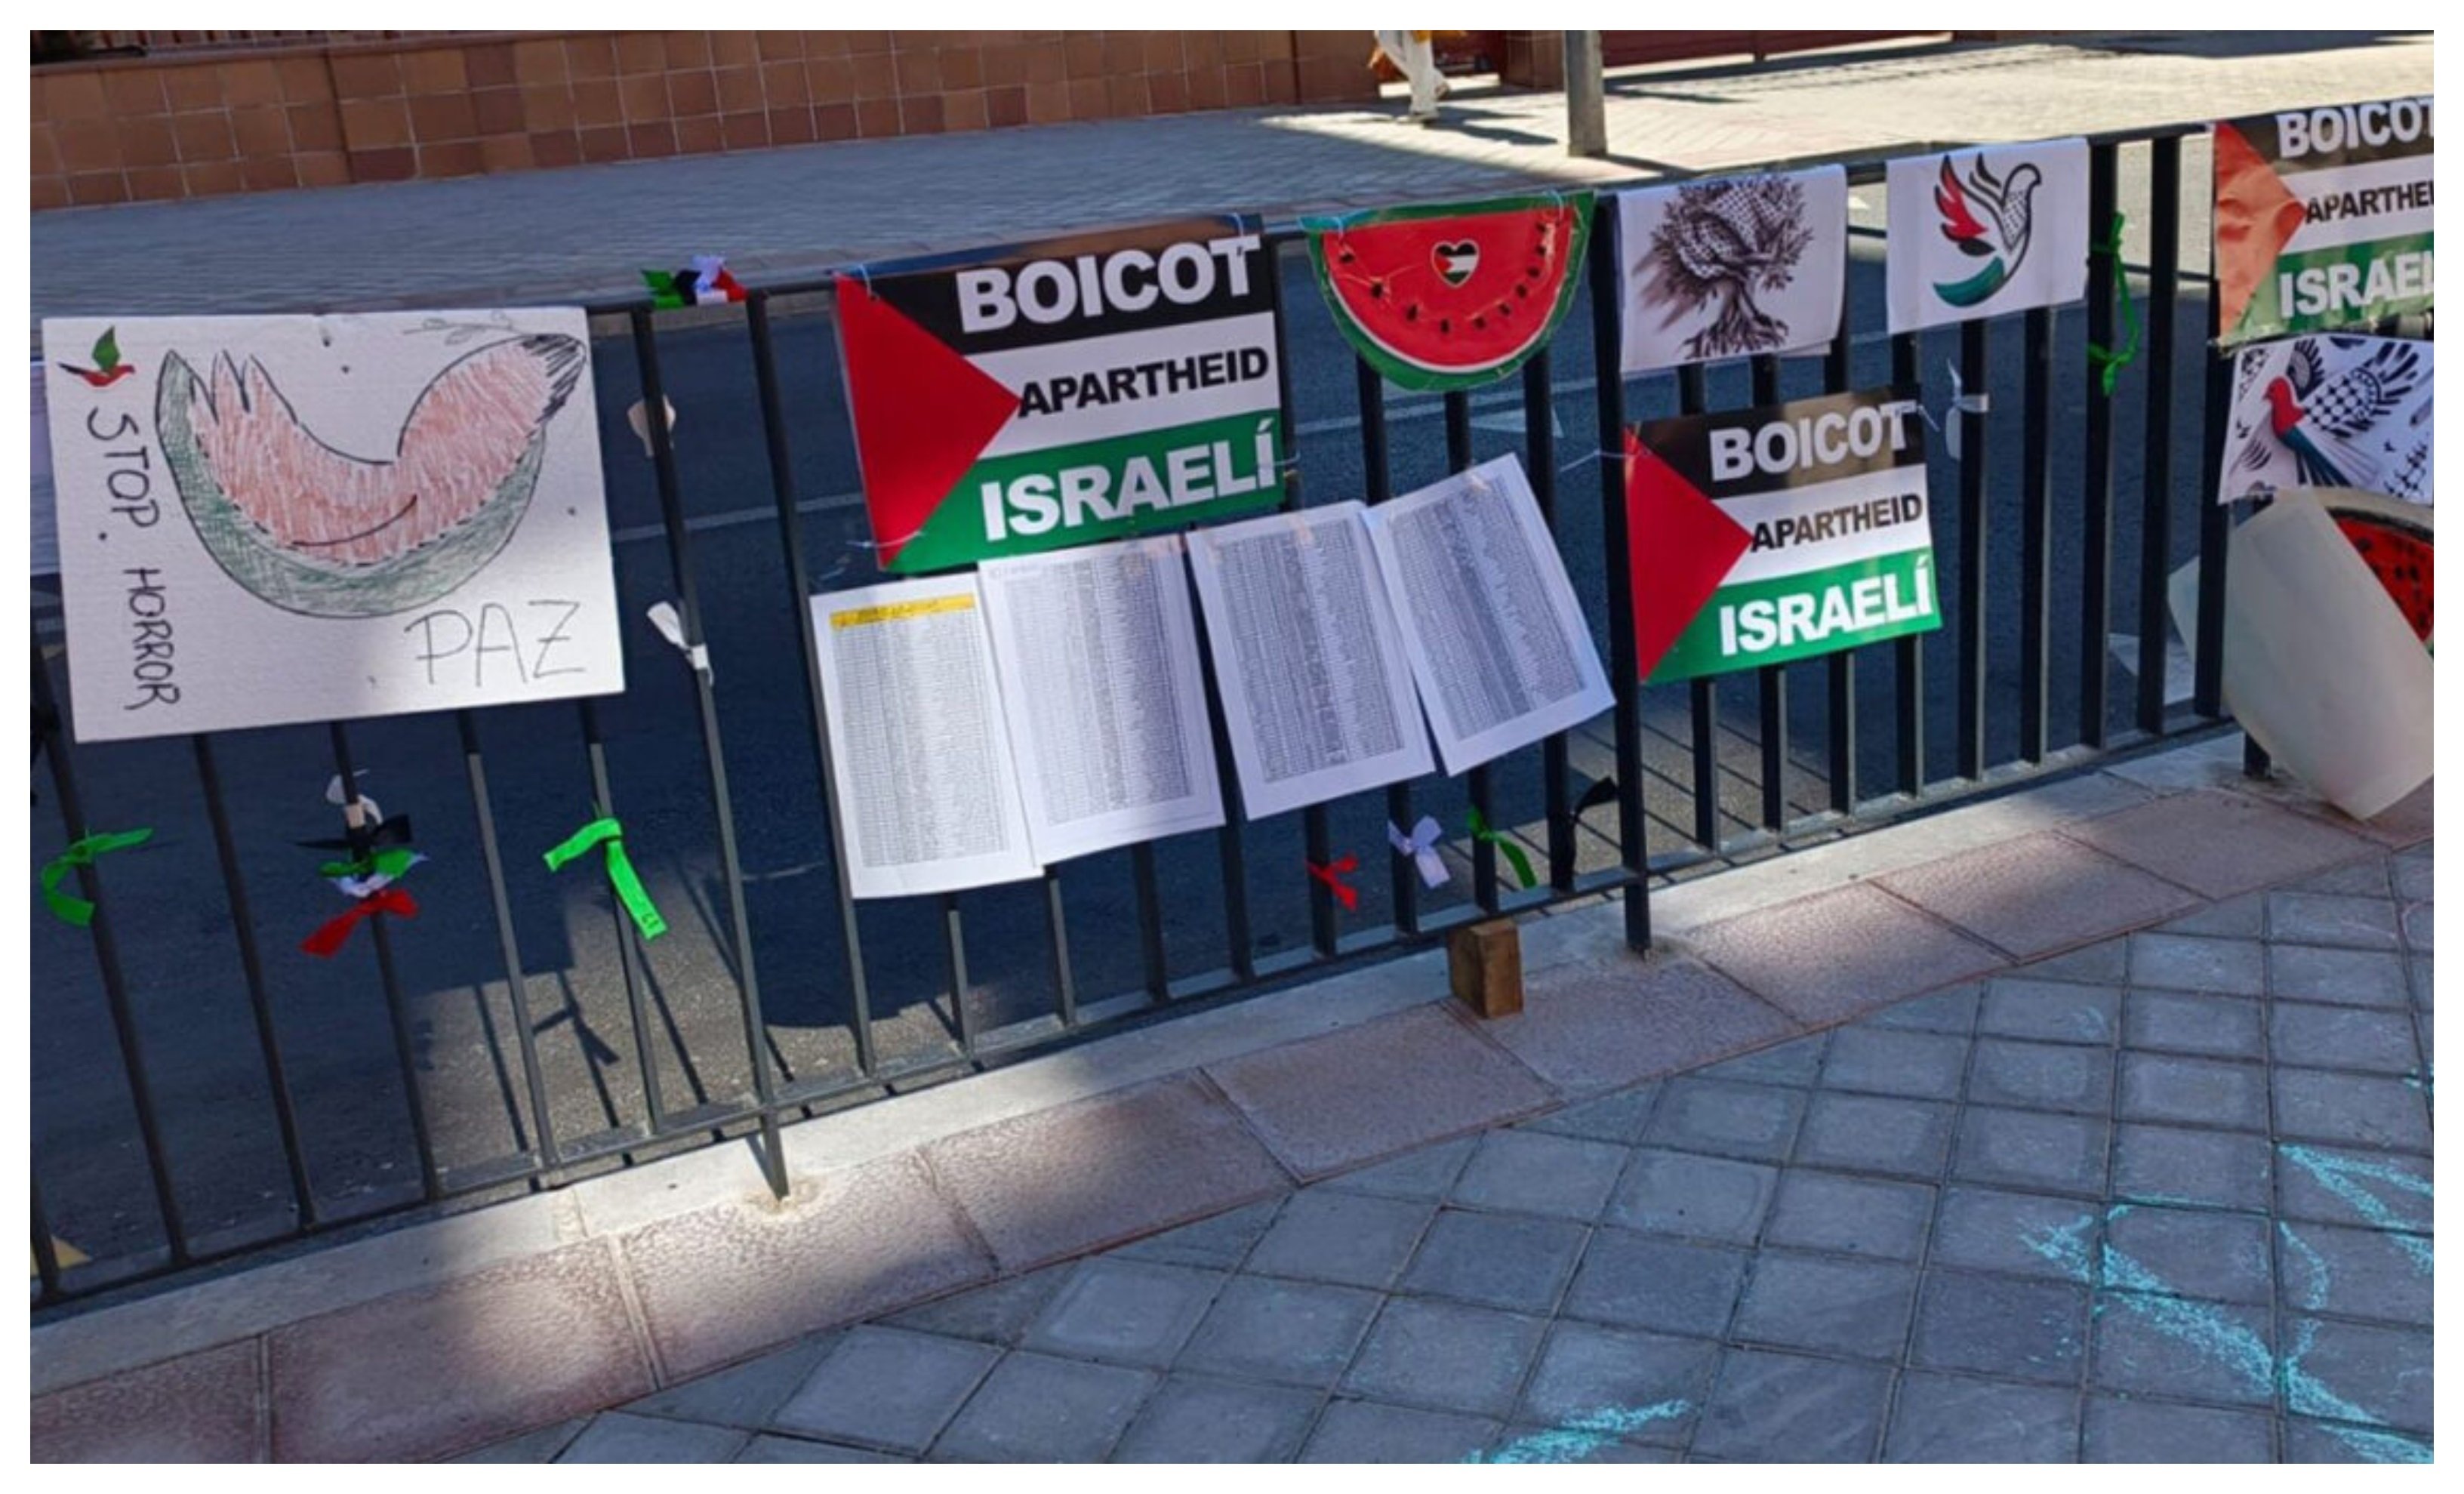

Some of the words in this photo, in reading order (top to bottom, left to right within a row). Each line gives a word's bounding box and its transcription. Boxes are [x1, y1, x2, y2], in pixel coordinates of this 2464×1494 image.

[956, 236, 1261, 333] BOICOT
[1018, 347, 1268, 417] APARTHEID
[981, 420, 1275, 541] ISRAELÍ
[1710, 400, 1917, 481] BOICOT
[1750, 494, 1922, 553] APARTHEID
[123, 568, 181, 711] HORROR
[404, 599, 585, 687] PAZ
[1720, 556, 1933, 656] ISRAELÍ
